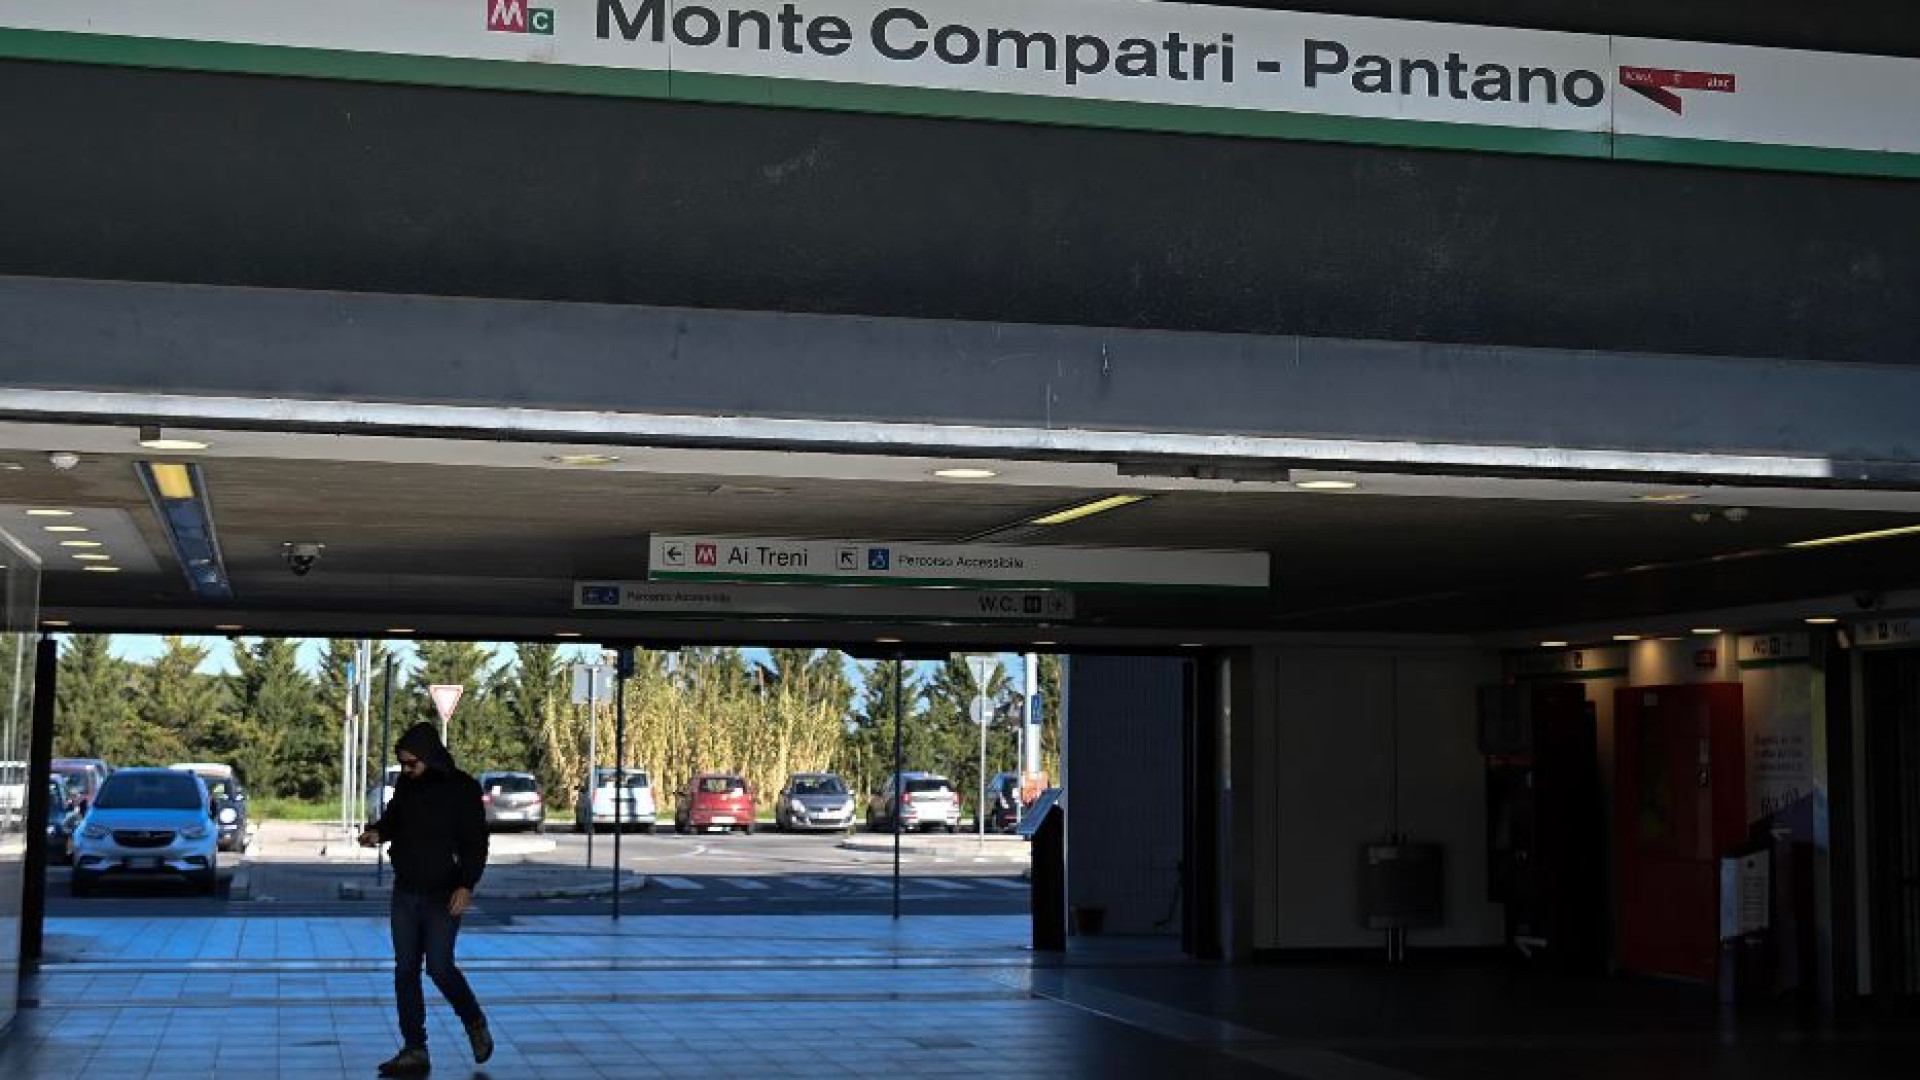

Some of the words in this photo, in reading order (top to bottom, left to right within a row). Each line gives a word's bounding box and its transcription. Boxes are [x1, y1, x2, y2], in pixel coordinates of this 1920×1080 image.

[596, 0, 853, 56] Monte
[870, 7, 1235, 85] Compatri
[1304, 38, 1606, 108] Pantano
[727, 546, 749, 565] Ai
[756, 546, 809, 567] Treni
[898, 553, 954, 567] Percorso
[956, 555, 1024, 570] Accessibile
[978, 594, 1018, 612] W.C.
